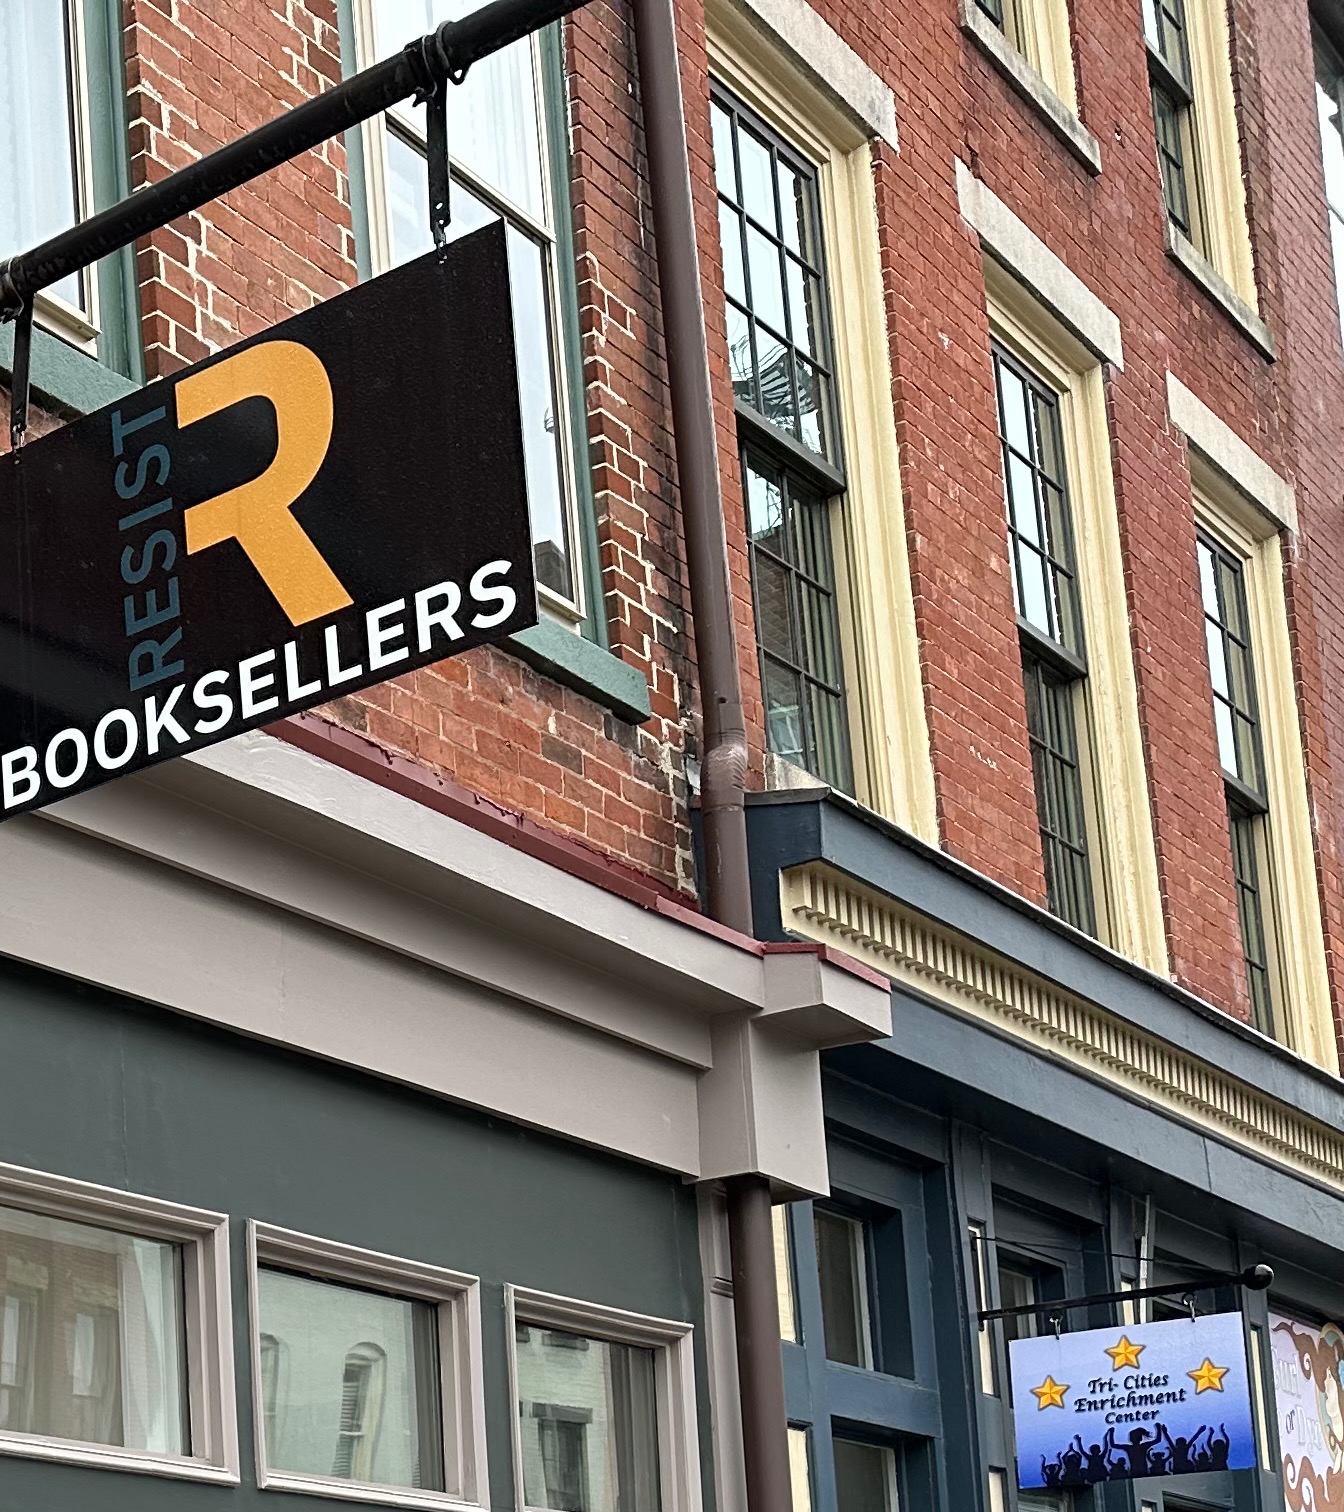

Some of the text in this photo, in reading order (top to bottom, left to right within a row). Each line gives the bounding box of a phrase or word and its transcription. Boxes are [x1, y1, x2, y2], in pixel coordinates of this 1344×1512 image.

[112, 405, 184, 693] RESIST
[174, 339, 354, 628] R
[0, 558, 518, 811] BOOKSELLERS
[1073, 1387, 1187, 1413] Enrichment
[1104, 1408, 1160, 1425] Center
[1123, 1372, 1169, 1390] Cities
